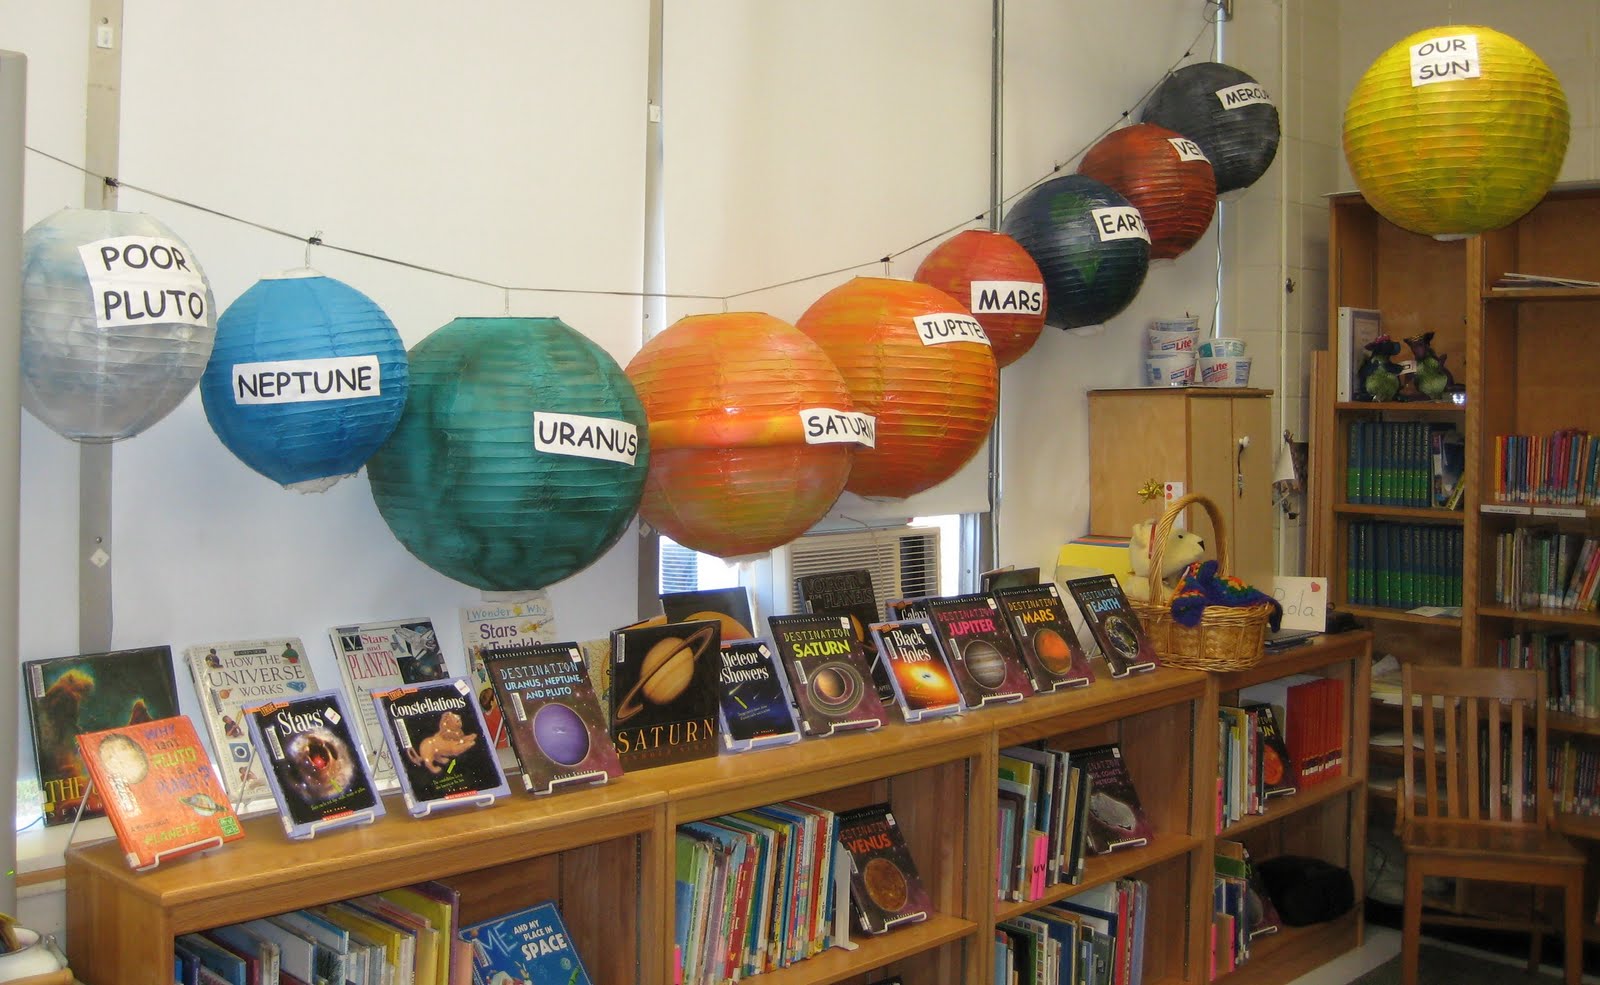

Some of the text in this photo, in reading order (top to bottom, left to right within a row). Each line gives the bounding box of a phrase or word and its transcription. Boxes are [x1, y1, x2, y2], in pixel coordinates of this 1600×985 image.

[1417, 38, 1467, 57] OUR
[1418, 59, 1470, 80] SUN
[1225, 88, 1270, 106] MERCU
[100, 244, 191, 271] POOR
[103, 289, 204, 321] PLUTO
[978, 289, 1041, 313] MARS
[1176, 339, 1193, 351] Lite
[1211, 362, 1228, 373] Lite
[237, 365, 373, 399] NEPTUNE
[807, 414, 876, 442] SATURN
[538, 420, 638, 458] URANUS
[472, 607, 512, 620] Wonder
[526, 604, 548, 616] Why
[1008, 597, 1059, 611] DESTINATION
[1090, 597, 1121, 612] EARTH
[901, 607, 929, 620] Galaxi
[938, 607, 996, 622] DESTINATION
[1022, 608, 1056, 625] MARS
[480, 623, 518, 640] Stars
[783, 628, 851, 642] DESTINATION
[891, 628, 926, 646] Black
[948, 619, 996, 637] JUPITER
[361, 633, 389, 645] Stars
[366, 643, 382, 652] and
[792, 639, 851, 658] SATURN
[898, 646, 932, 664] Holes
[225, 655, 282, 670] HOW THE
[347, 650, 400, 681] PLANETS
[721, 651, 759, 668] Meteor
[209, 664, 306, 687] UNIVERSE
[500, 660, 579, 681] DESTINATION
[722, 666, 770, 685] Showers
[239, 683, 284, 698] WORKS
[504, 674, 585, 692] URANUS, NEPTUNE,
[526, 686, 573, 700] AND PLUTO
[390, 695, 467, 719] Constellations
[144, 723, 176, 740] WHY
[277, 708, 325, 737] Stars
[616, 718, 715, 754] SATURN
[151, 746, 197, 768] PLUTO
[44, 776, 85, 803] THE
[144, 822, 200, 845] PLANETS
[839, 820, 892, 841] ESTINATION
[847, 833, 893, 854] VENUS
[513, 924, 529, 935] AND
[528, 919, 541, 930] MY
[522, 925, 554, 942] PLACE IN
[520, 932, 568, 962] SPACE
